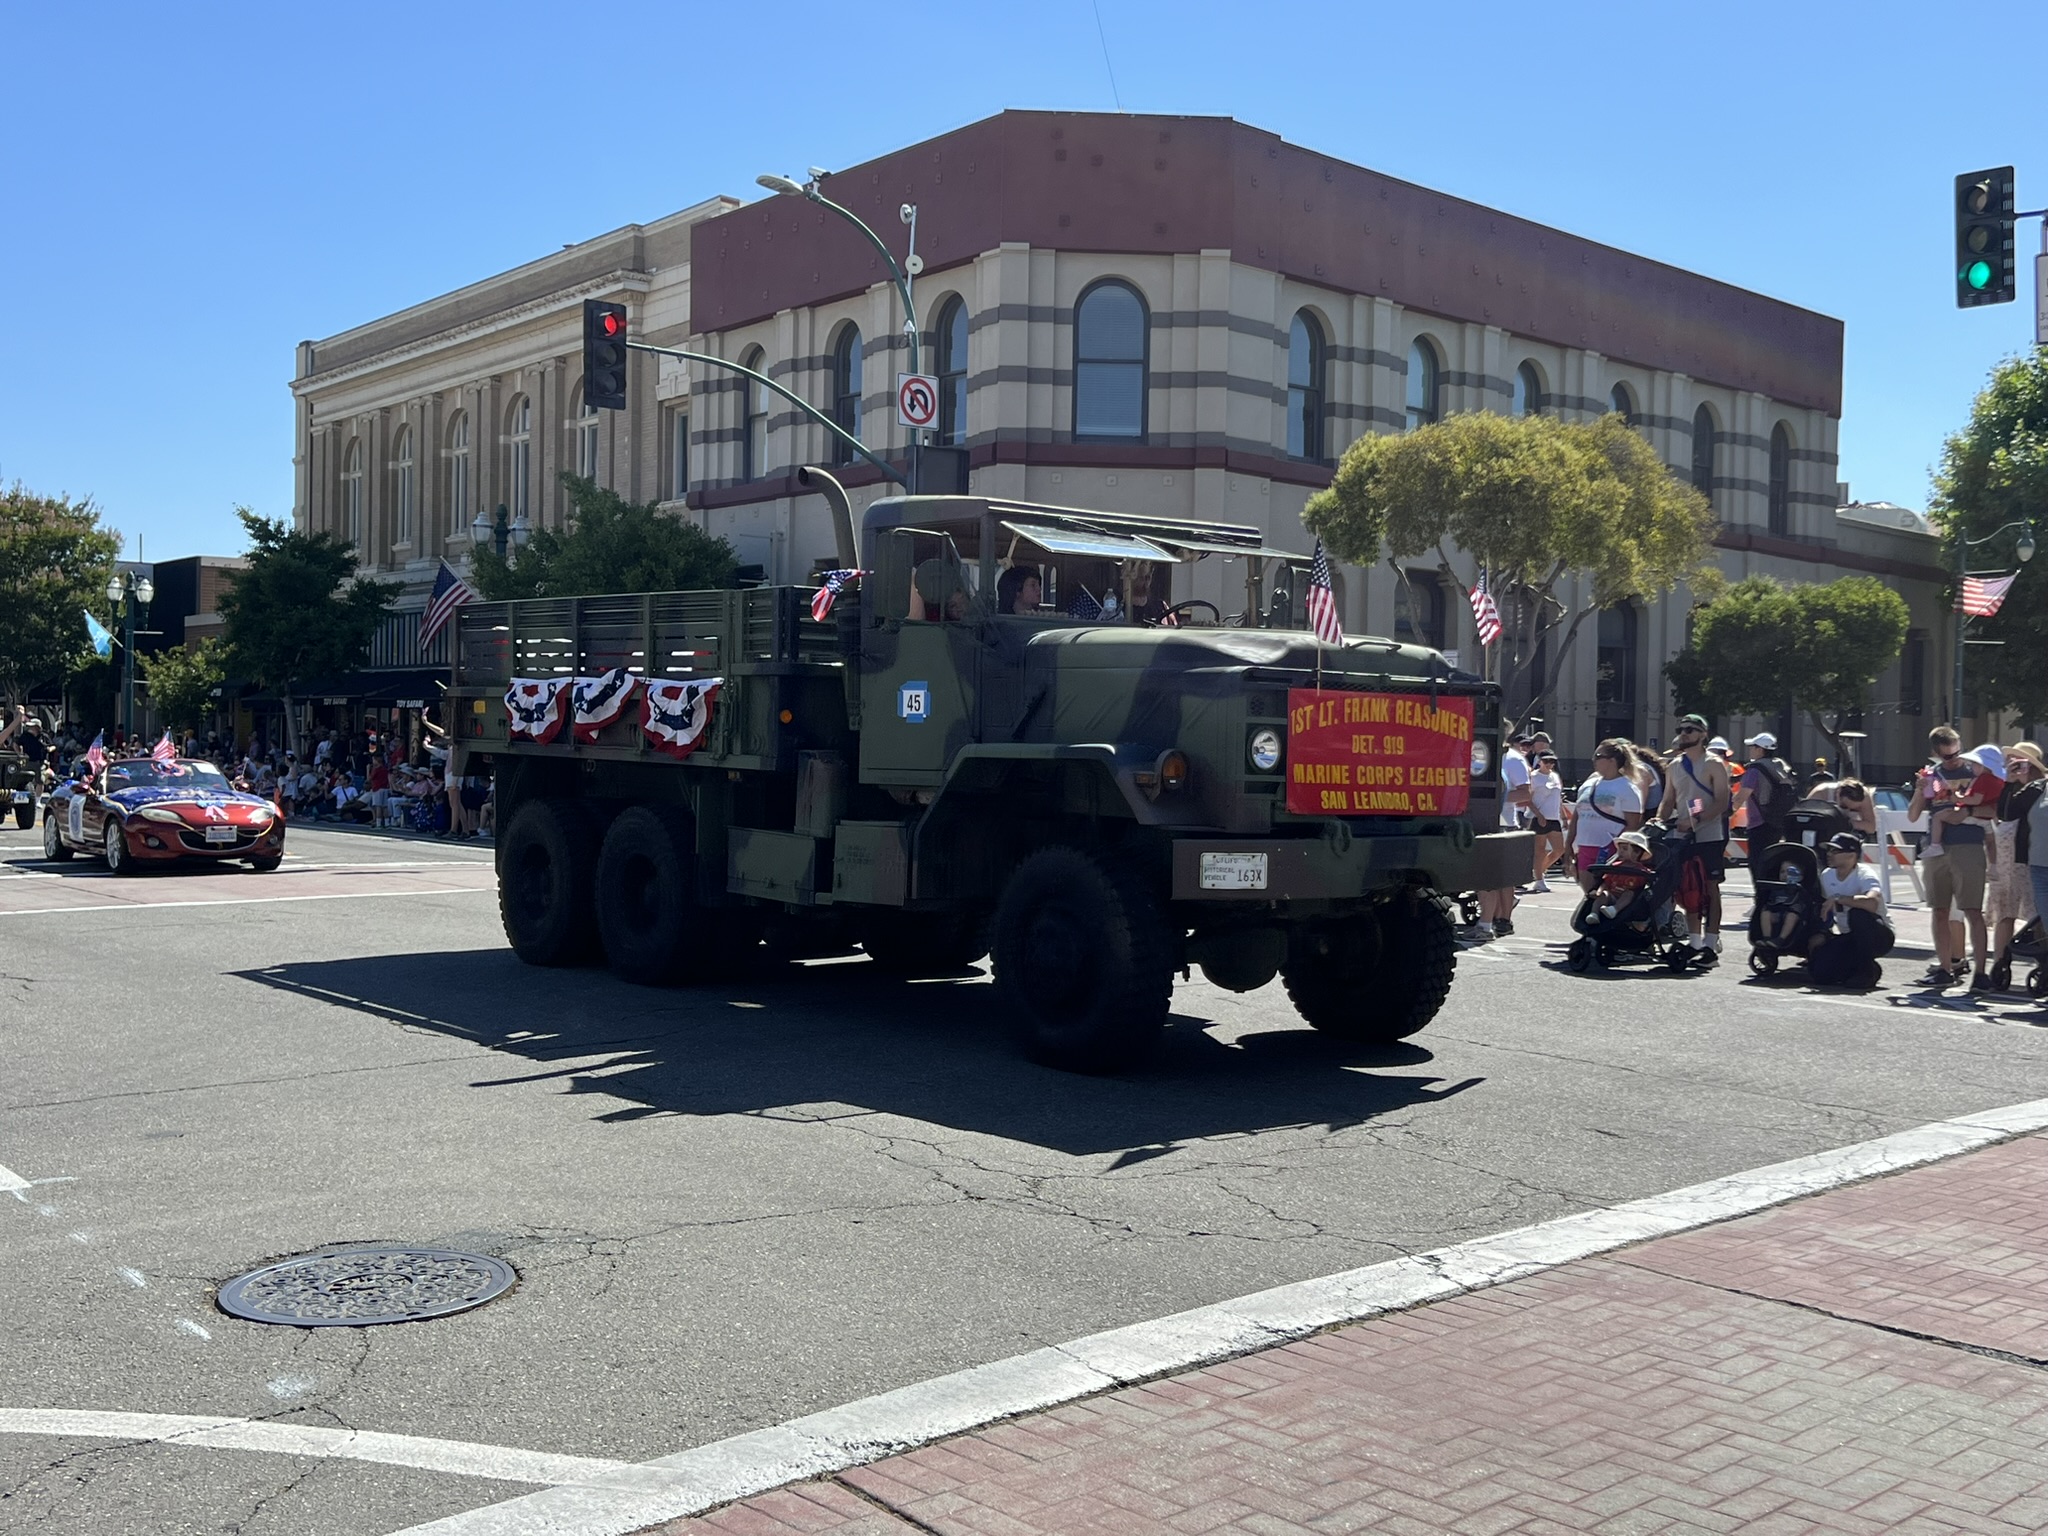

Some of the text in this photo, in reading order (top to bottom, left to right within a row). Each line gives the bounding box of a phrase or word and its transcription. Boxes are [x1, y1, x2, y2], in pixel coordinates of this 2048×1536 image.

[396, 700, 424, 708] TOY SAFARI
[907, 694, 921, 712] 45
[1291, 697, 1469, 742] 1ST LT. FRANK REASONER
[1352, 735, 1404, 755] DET. 919
[1293, 763, 1468, 787] MARINE CORPS LEAGUE
[1320, 790, 1438, 813] SAN LEANDRO, CA.
[1237, 869, 1262, 882] 163X
